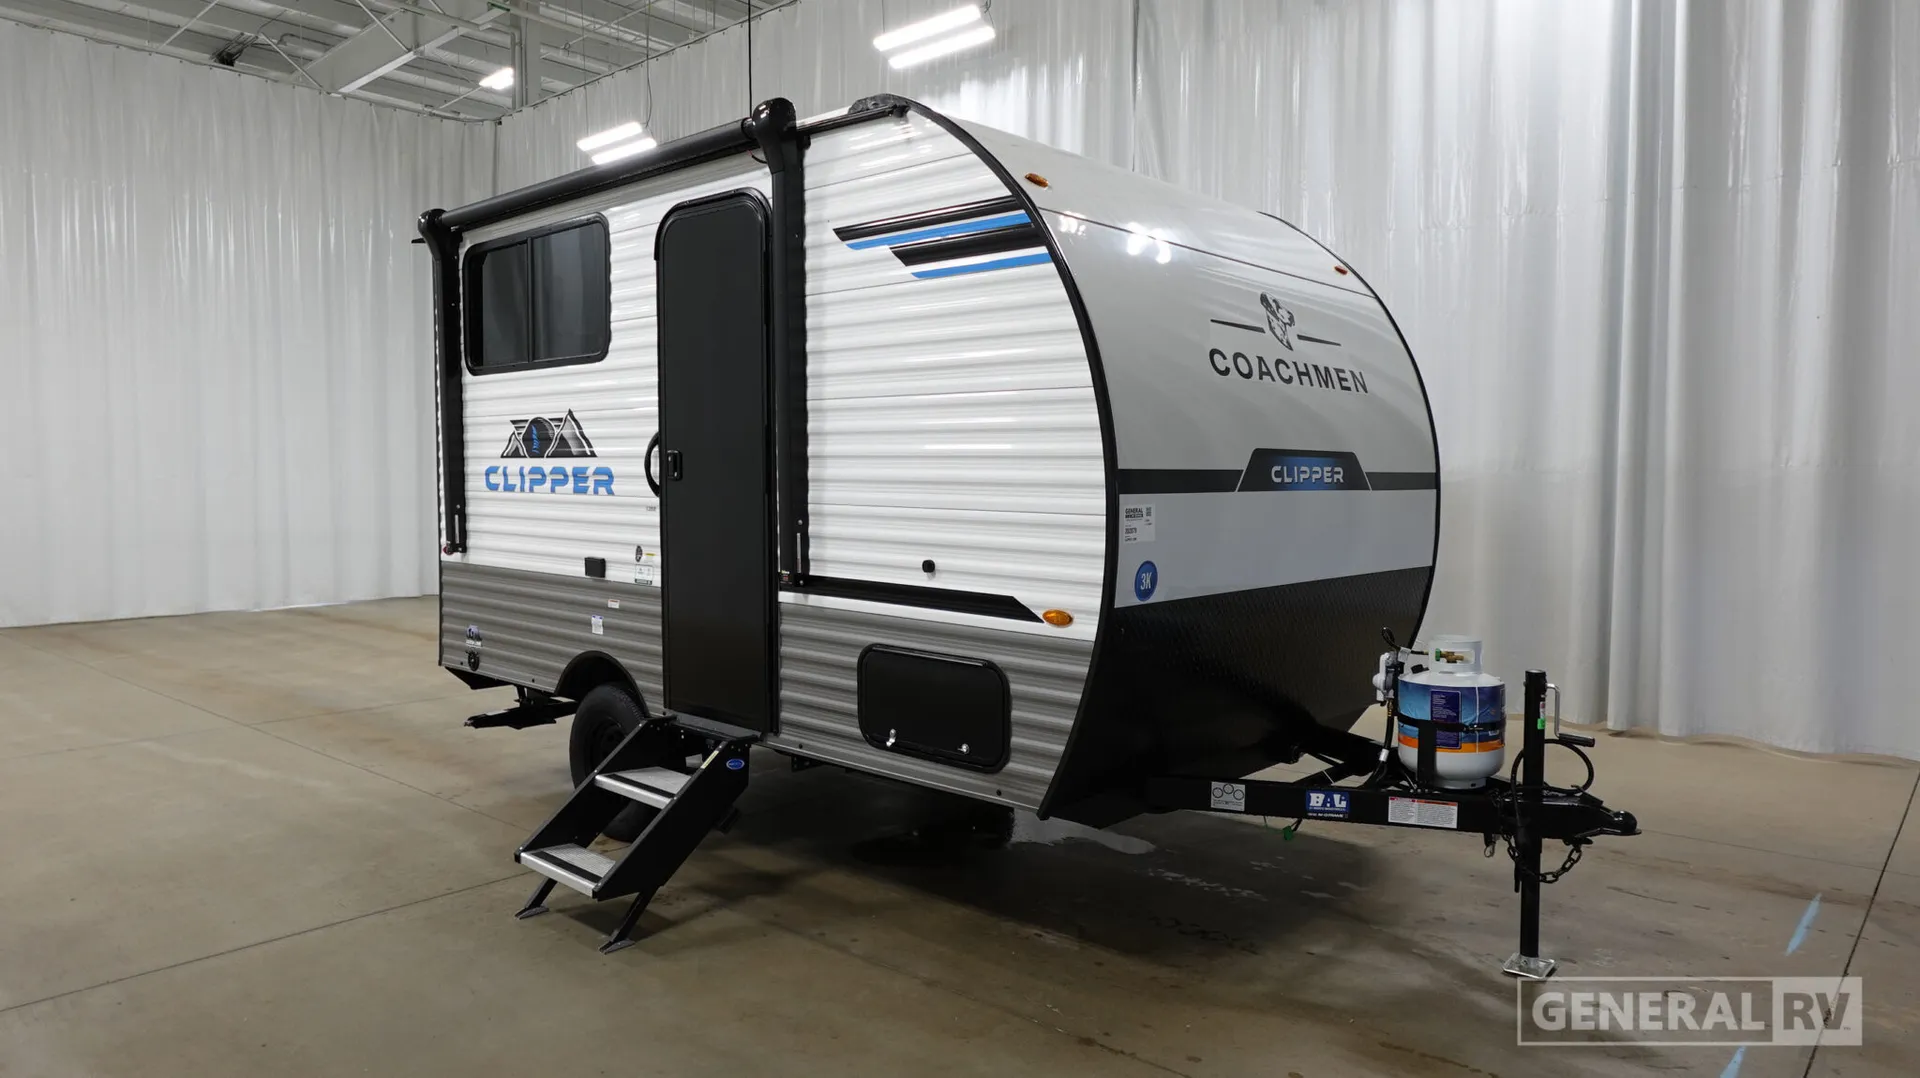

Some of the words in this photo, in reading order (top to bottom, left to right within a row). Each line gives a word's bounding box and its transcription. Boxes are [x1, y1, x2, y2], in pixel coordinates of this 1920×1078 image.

[1209, 348, 1369, 394] COACHMEN
[485, 465, 615, 496] CLIPPER
[1271, 465, 1344, 483] CLIPPER
[1140, 571, 1152, 590] 3K
